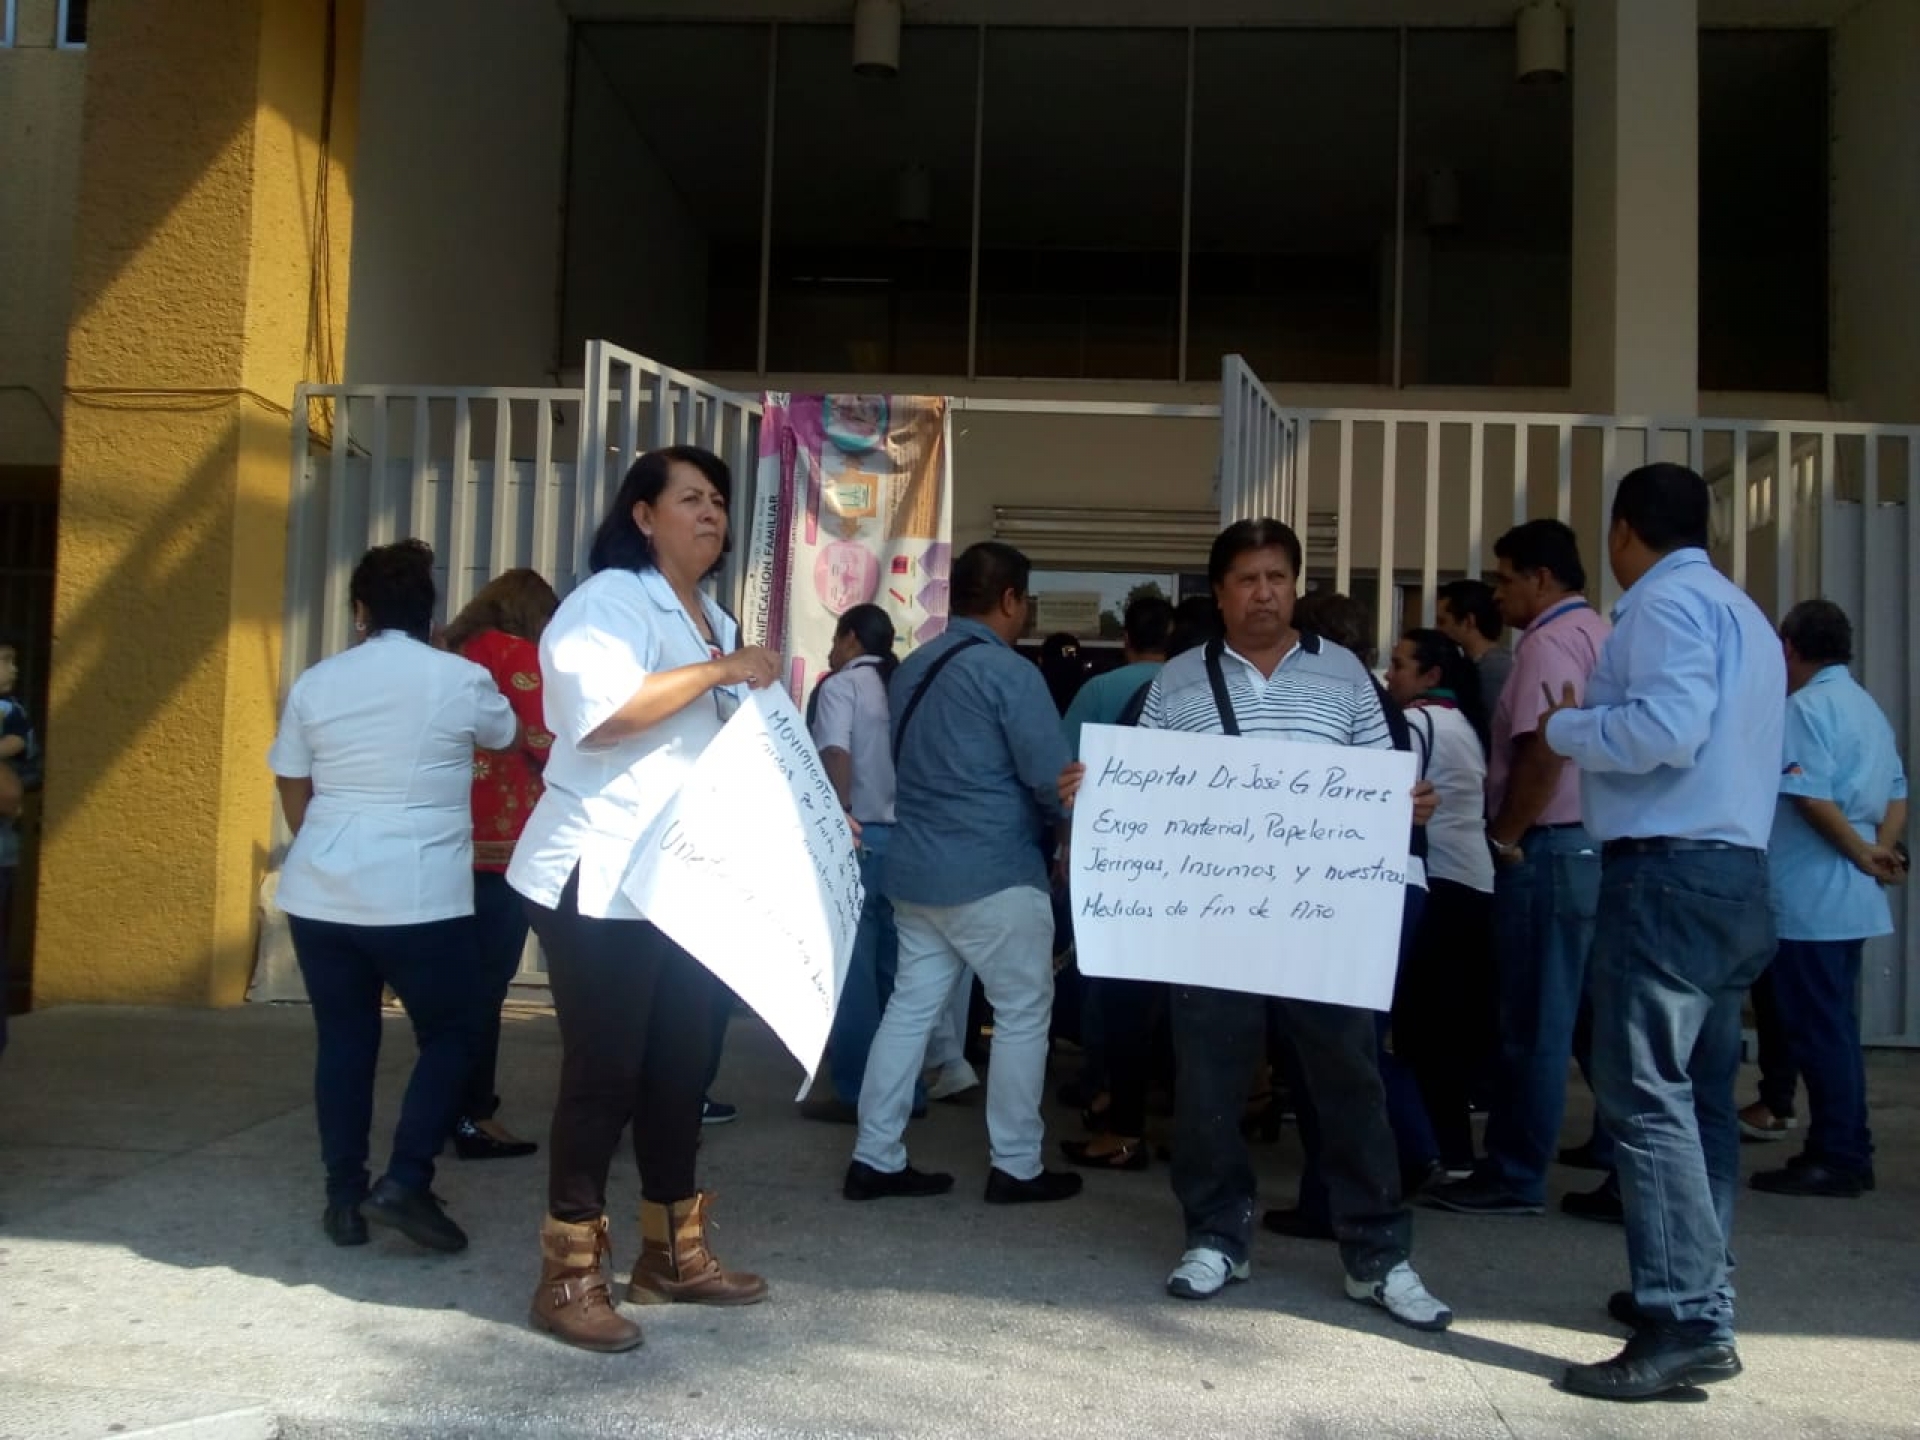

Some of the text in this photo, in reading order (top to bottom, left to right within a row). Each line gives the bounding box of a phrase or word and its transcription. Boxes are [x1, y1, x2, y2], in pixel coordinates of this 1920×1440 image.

[756, 561, 773, 648] ANIFICACION
[766, 495, 780, 556] FAMILIAR
[1098, 756, 1392, 803] Hospital Dr José G Parres
[1164, 816, 1256, 843] material,
[1265, 812, 1366, 847] Papeleria
[1164, 899, 1189, 917] de
[1290, 900, 1335, 919] Año
